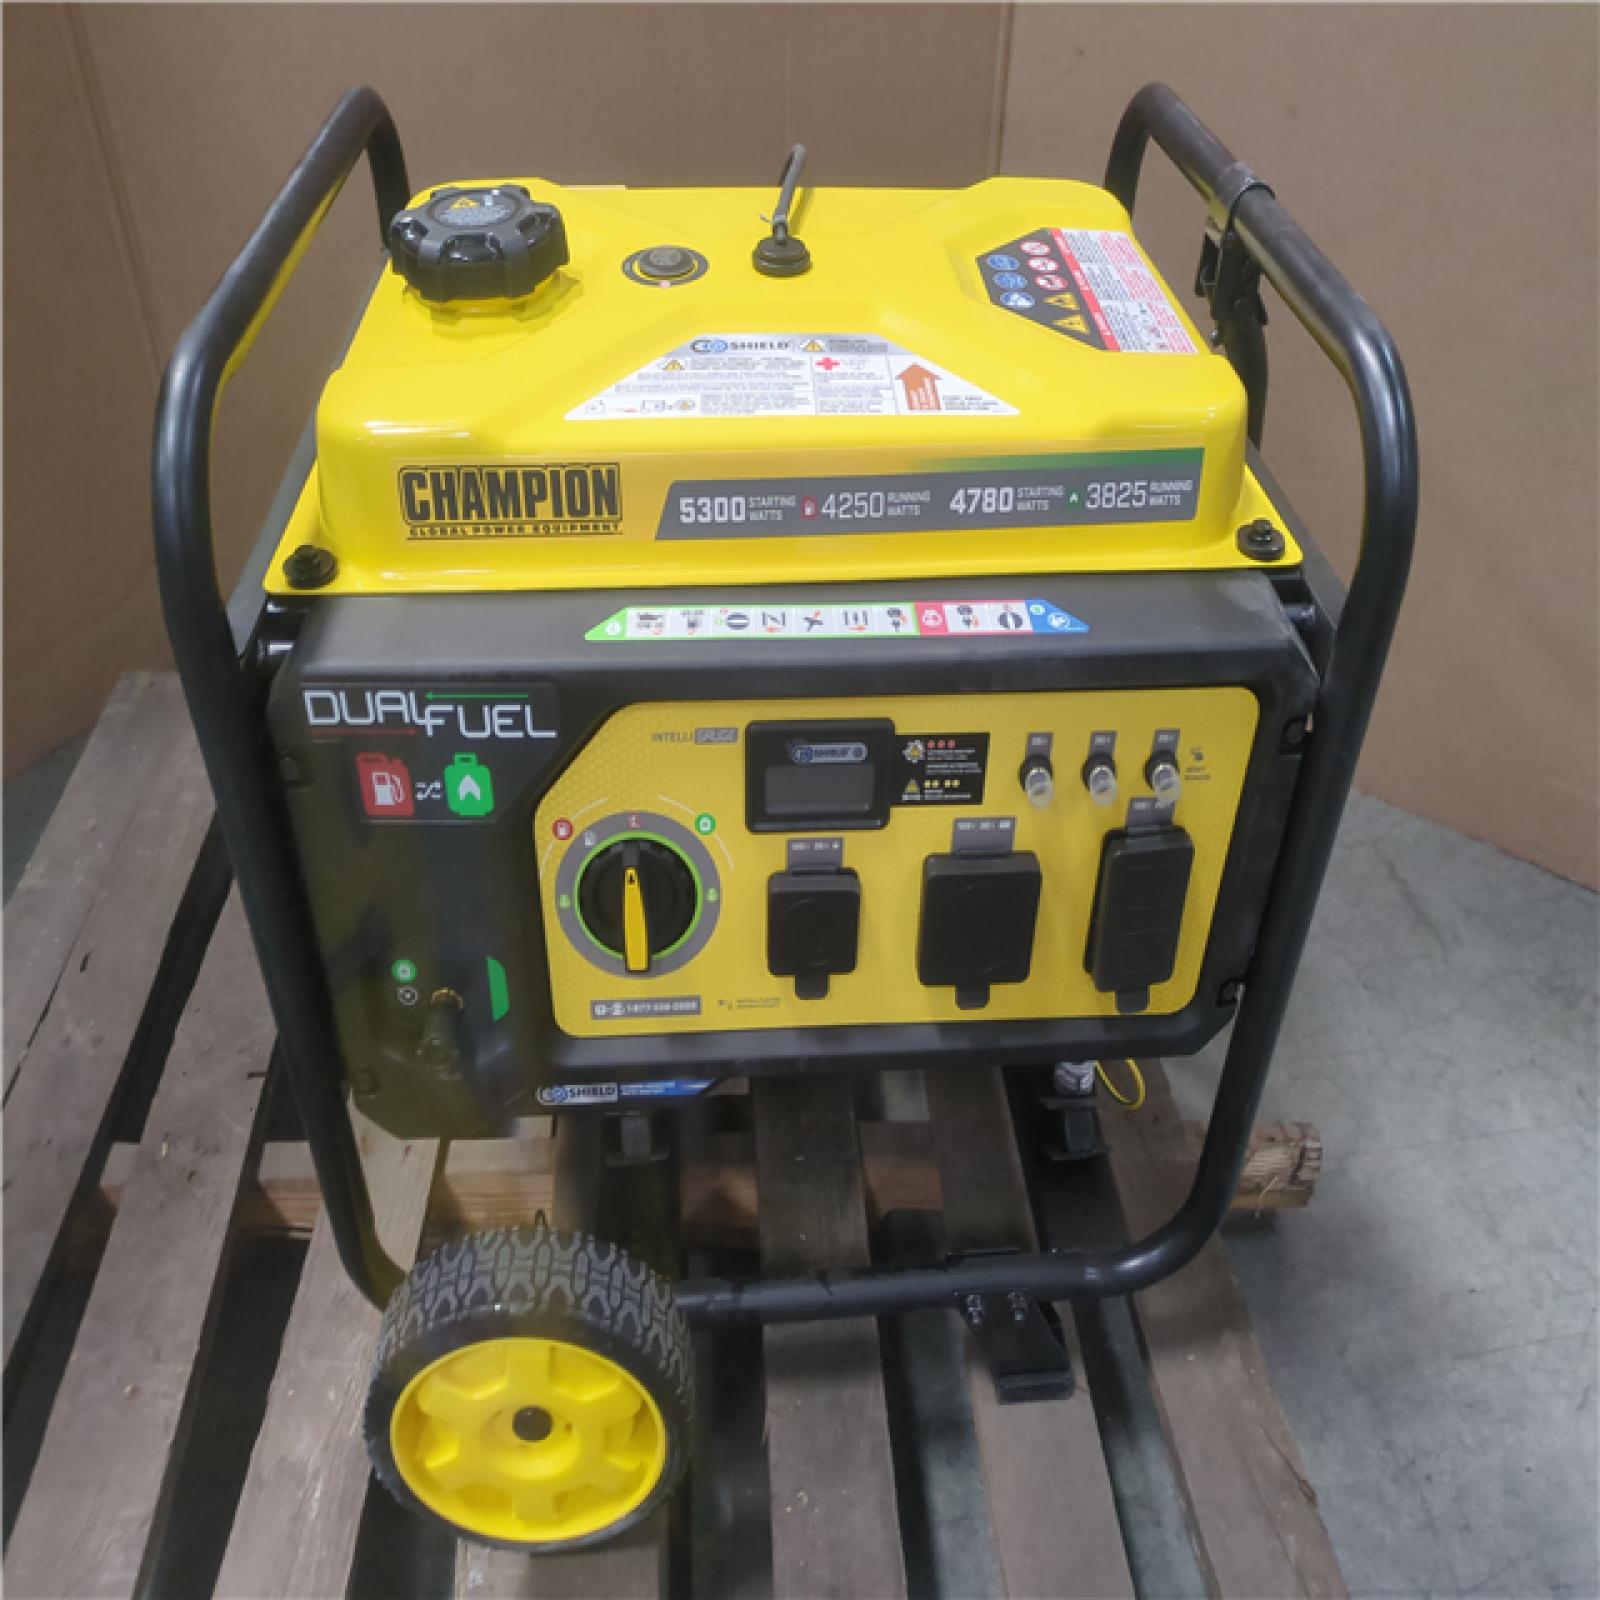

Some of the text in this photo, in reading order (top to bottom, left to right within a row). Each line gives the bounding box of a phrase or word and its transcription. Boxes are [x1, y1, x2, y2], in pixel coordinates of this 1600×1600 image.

[401, 468, 620, 521] CHAMPION
[821, 489, 931, 519] 4250 RUNNING
[949, 484, 1064, 514] 4780 STARTING
[1085, 479, 1194, 510] 3825 RUNNING
[1150, 494, 1181, 506] WATTS
[679, 494, 796, 524] 5300 STARTING
[749, 509, 783, 521] WATTS
[887, 504, 921, 516] WATTS
[1017, 500, 1049, 511] WATTS
[471, 525, 526, 534] POWER
[531, 522, 619, 533] EQUIPMENT
